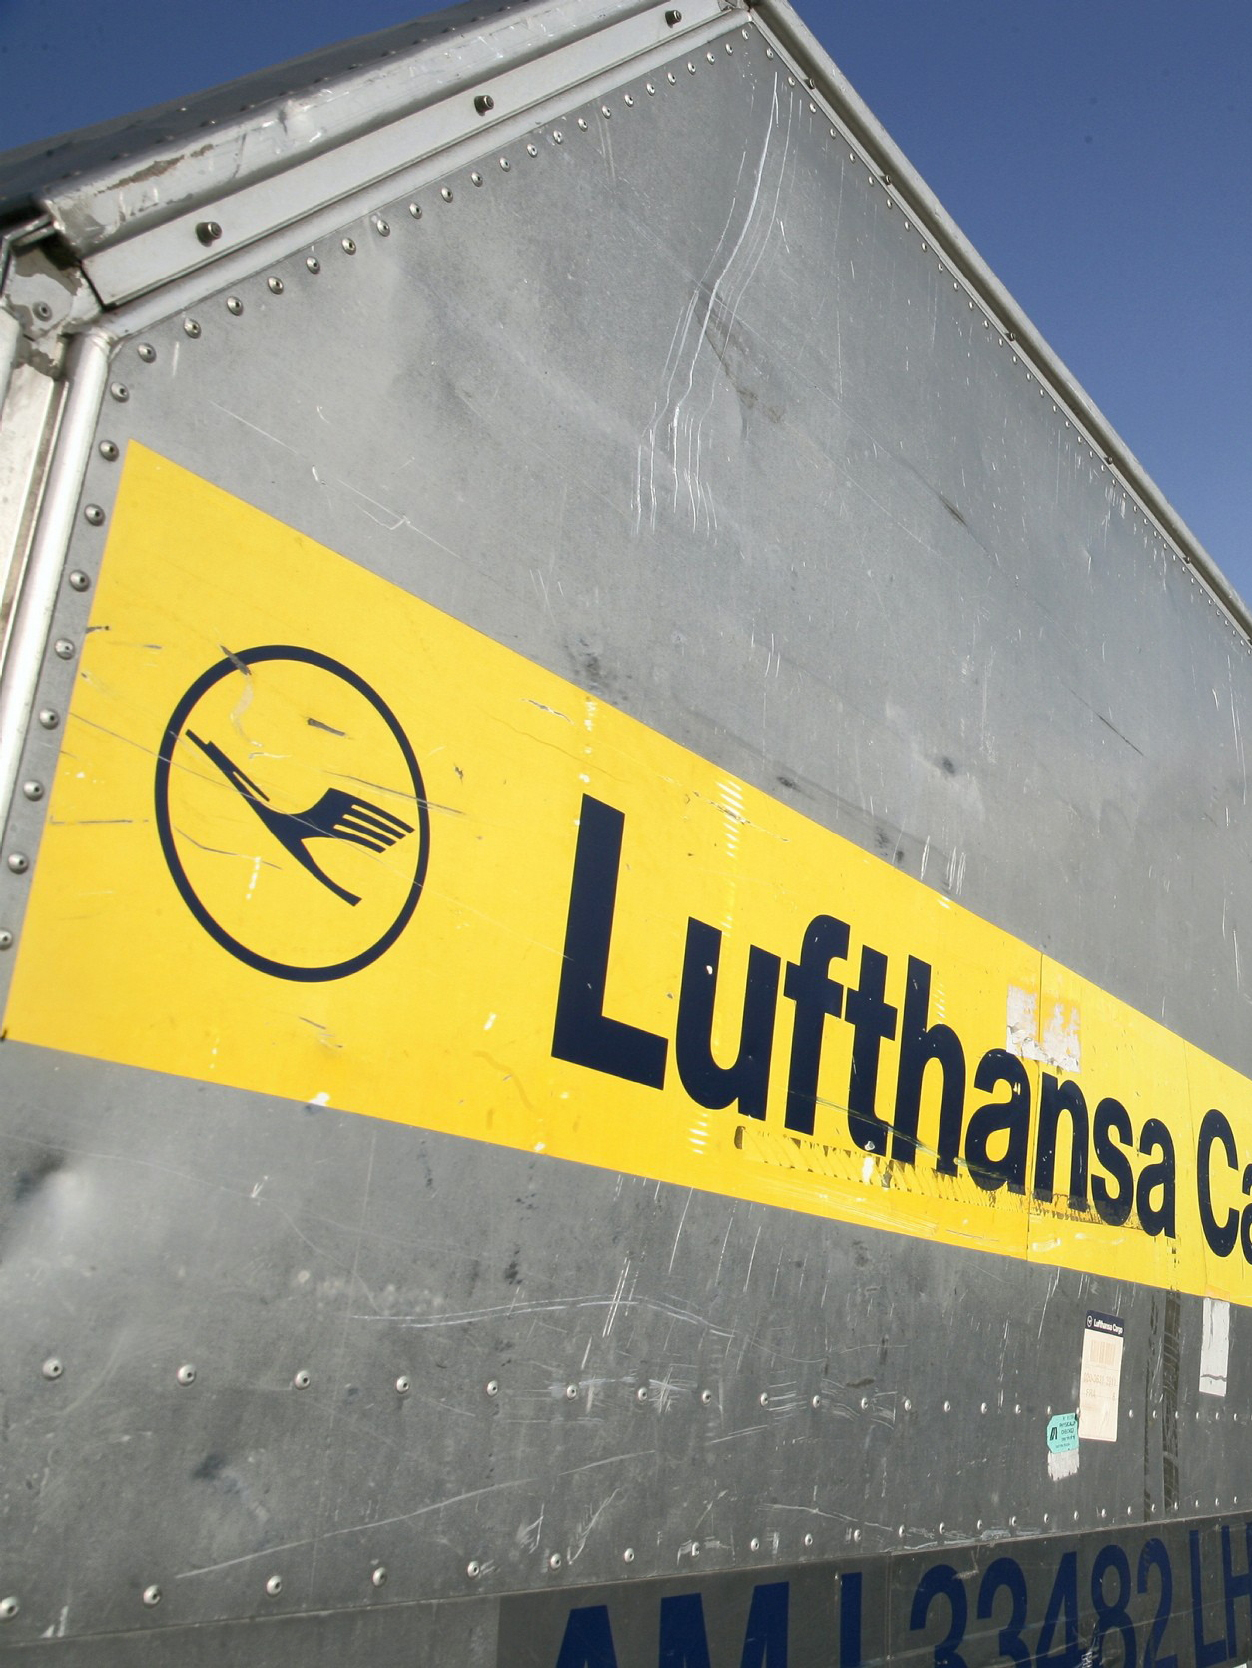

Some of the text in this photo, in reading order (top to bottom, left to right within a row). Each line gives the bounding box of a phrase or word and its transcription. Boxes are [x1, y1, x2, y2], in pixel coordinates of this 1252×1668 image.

[551, 792, 1176, 1239] Lufthansa
[1093, 1318, 1123, 1334] Lufthansa Cargo
